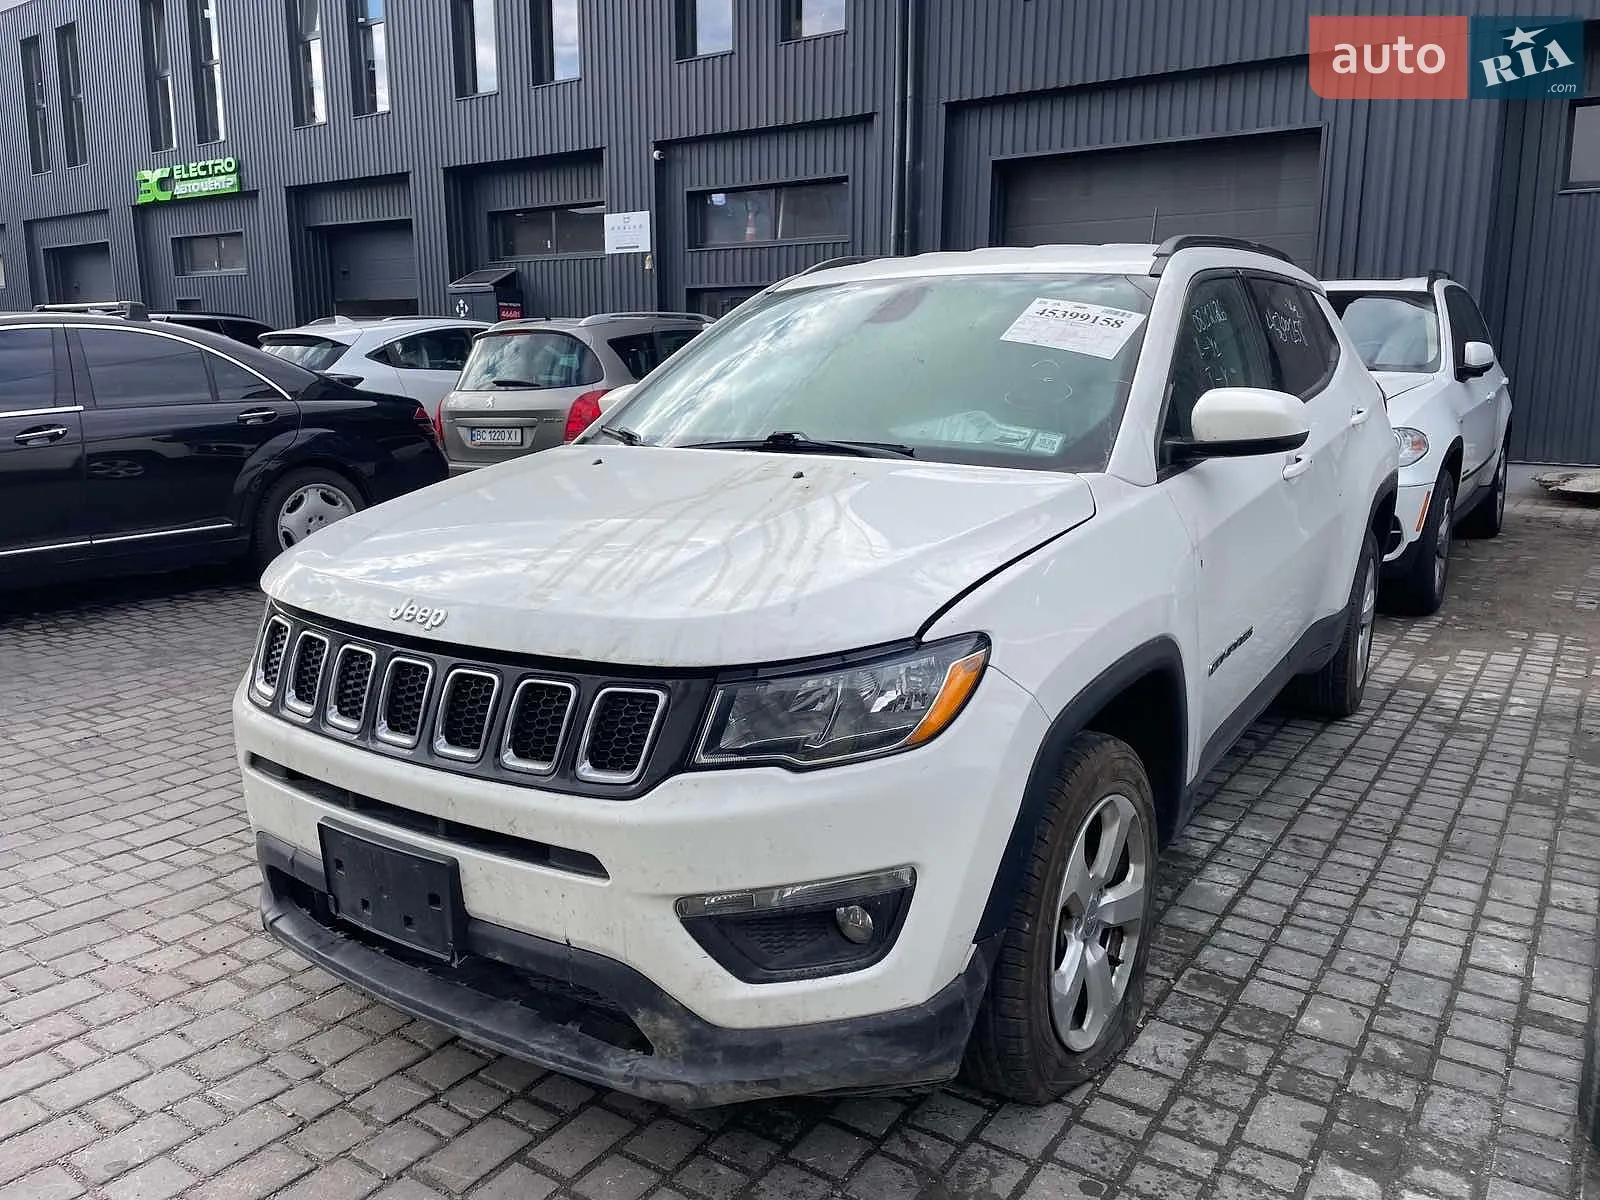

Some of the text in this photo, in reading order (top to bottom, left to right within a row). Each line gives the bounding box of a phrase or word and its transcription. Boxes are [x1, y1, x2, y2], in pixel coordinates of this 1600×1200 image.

[173, 157, 236, 180] ELECTRO
[1035, 307, 1125, 329] 45399158
[475, 430, 487, 441] BC
[488, 430, 506, 441] 1220
[388, 598, 449, 632] Jeep
